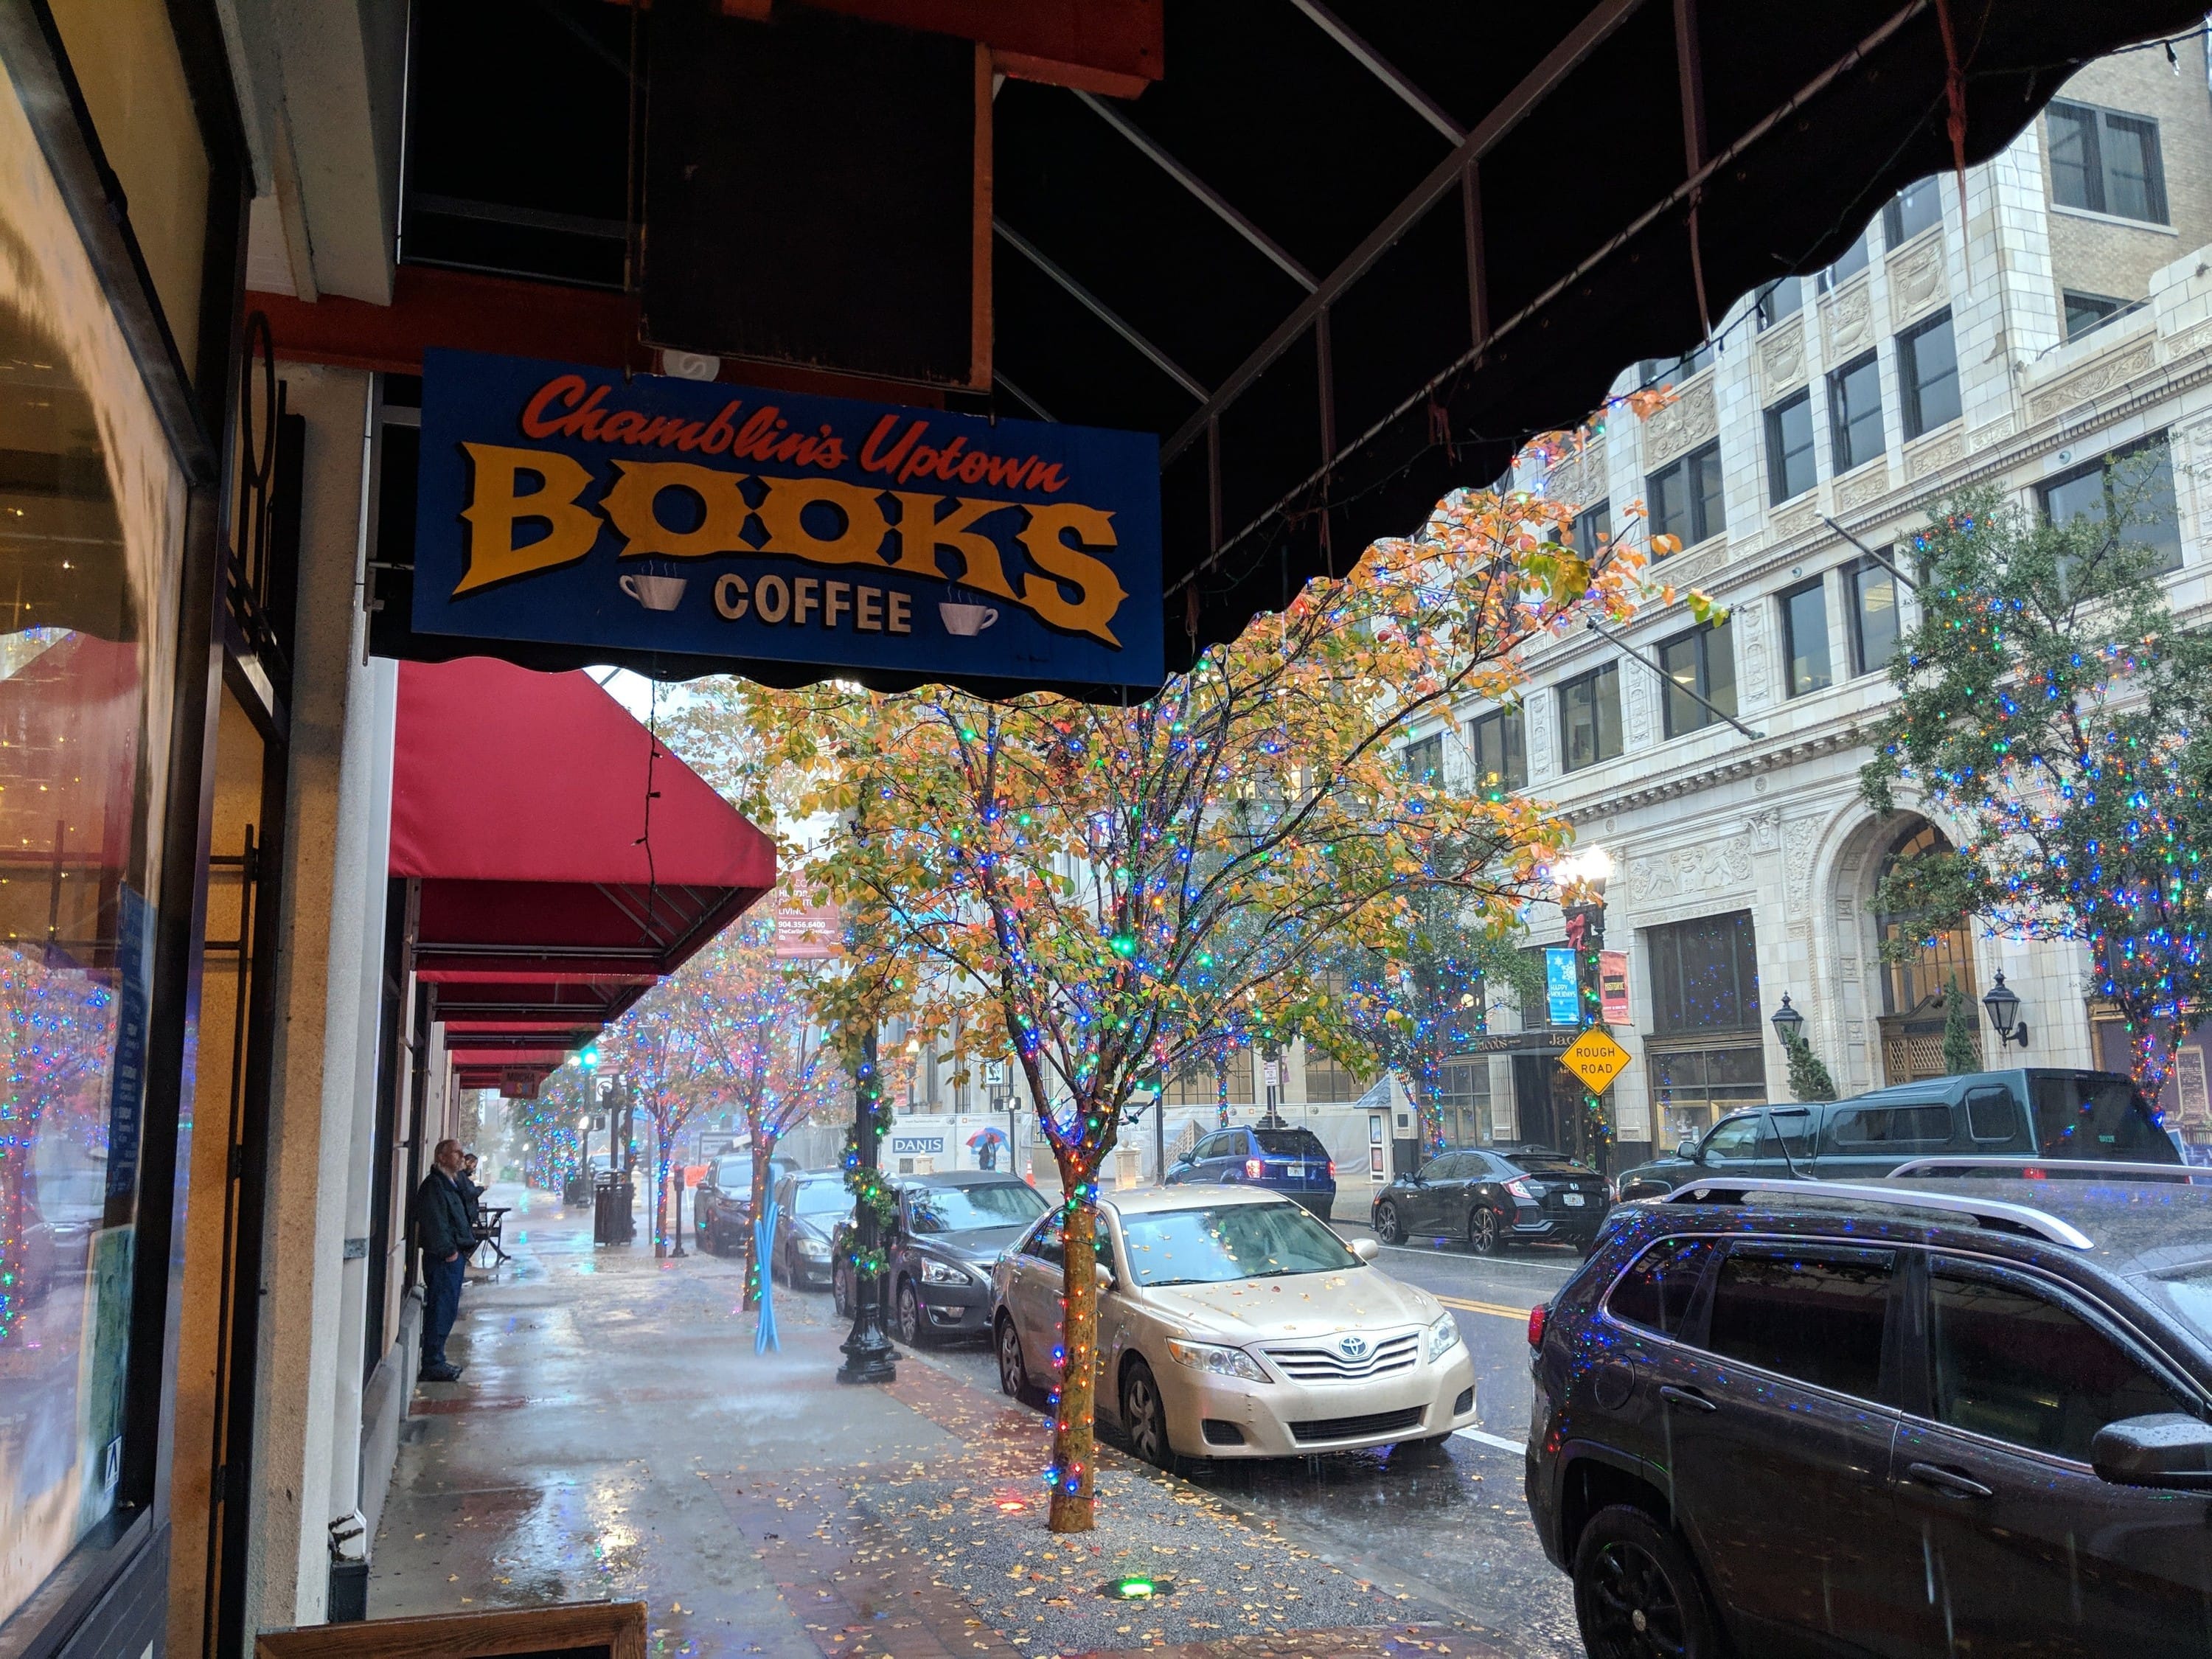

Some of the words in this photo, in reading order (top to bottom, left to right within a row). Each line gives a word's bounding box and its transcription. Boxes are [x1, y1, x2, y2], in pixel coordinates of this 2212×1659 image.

[521, 374, 848, 470] Chamblin's
[860, 414, 1069, 493] Uptown
[453, 442, 1130, 649] BOOKS
[714, 573, 913, 633] COFFEE
[1576, 1047, 1615, 1057] ROUGH
[1581, 1063, 1613, 1074] ROAD
[894, 1139, 942, 1150] DANIS
